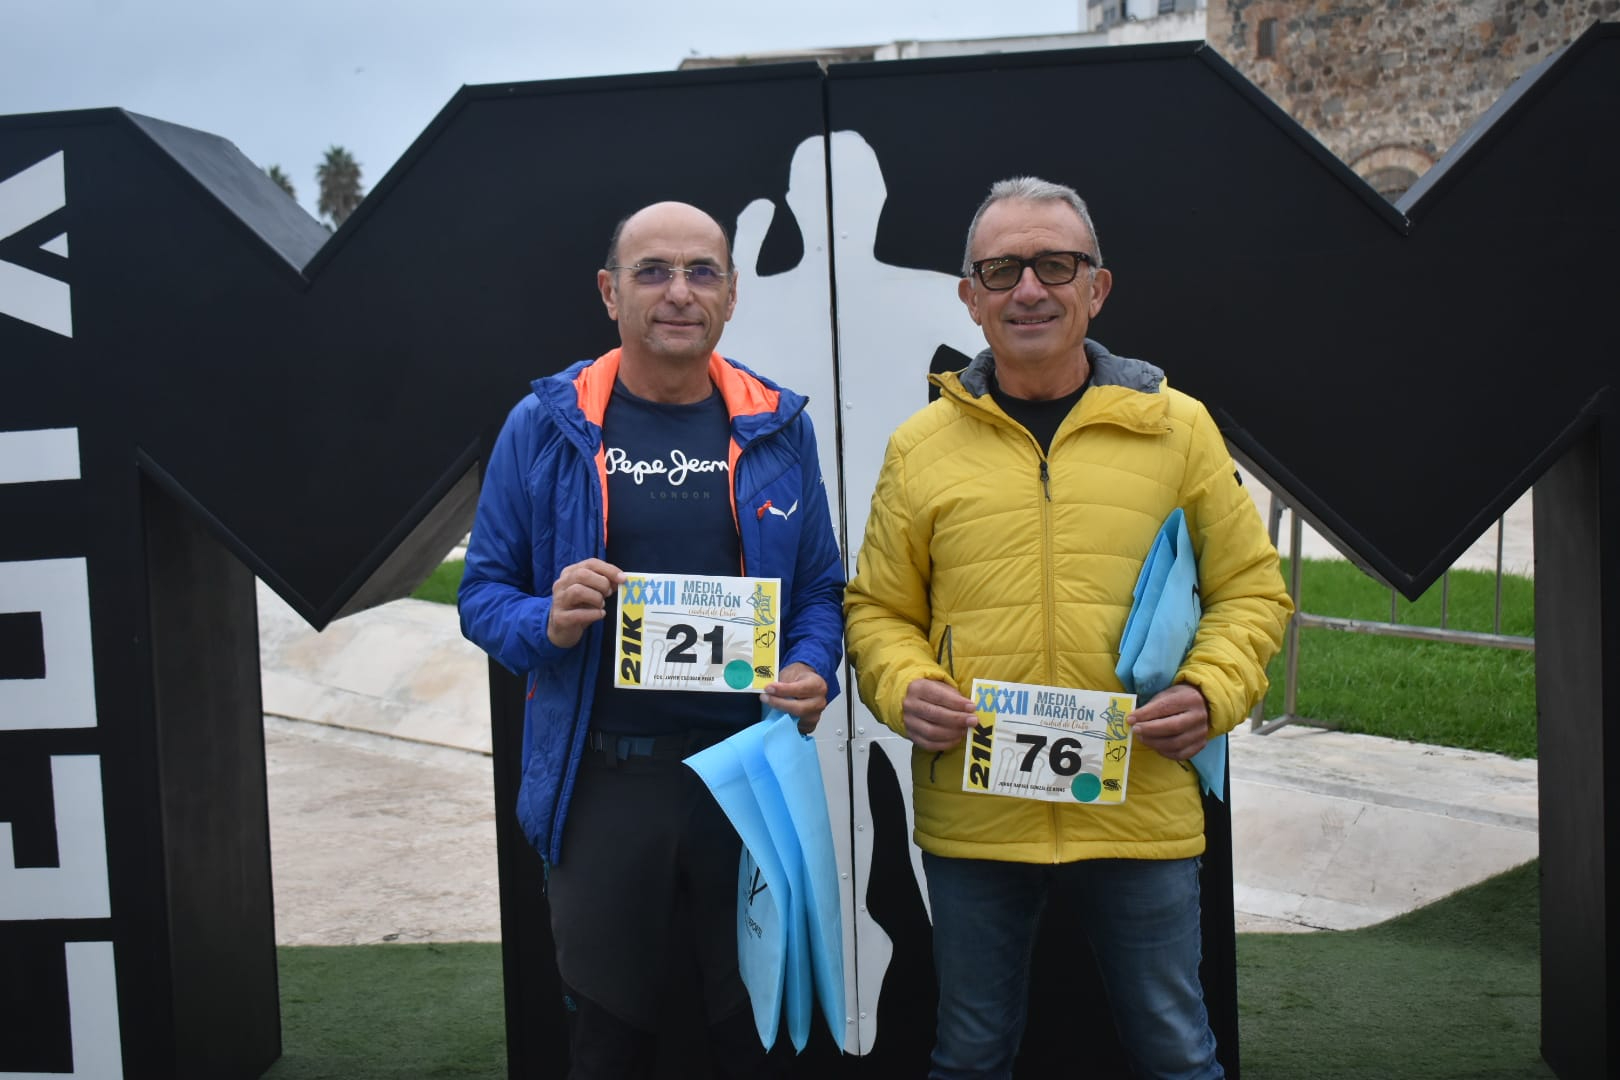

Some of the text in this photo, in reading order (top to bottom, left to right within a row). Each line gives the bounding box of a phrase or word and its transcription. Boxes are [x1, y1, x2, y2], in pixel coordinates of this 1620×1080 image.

[604, 447, 667, 485] Pepe
[649, 491, 711, 500] LONDON
[623, 579, 676, 606] XXXII
[680, 592, 741, 608] MARATÓN
[683, 580, 723, 595] MEDIA
[620, 611, 643, 684] 21K
[664, 623, 725, 665] 21
[975, 686, 1029, 715] XXXII
[1036, 691, 1077, 707] MEDIA
[1033, 704, 1095, 722] MARATÓN
[1062, 720, 1071, 728] de
[969, 725, 994, 789] 21K
[1015, 733, 1082, 777] 76
